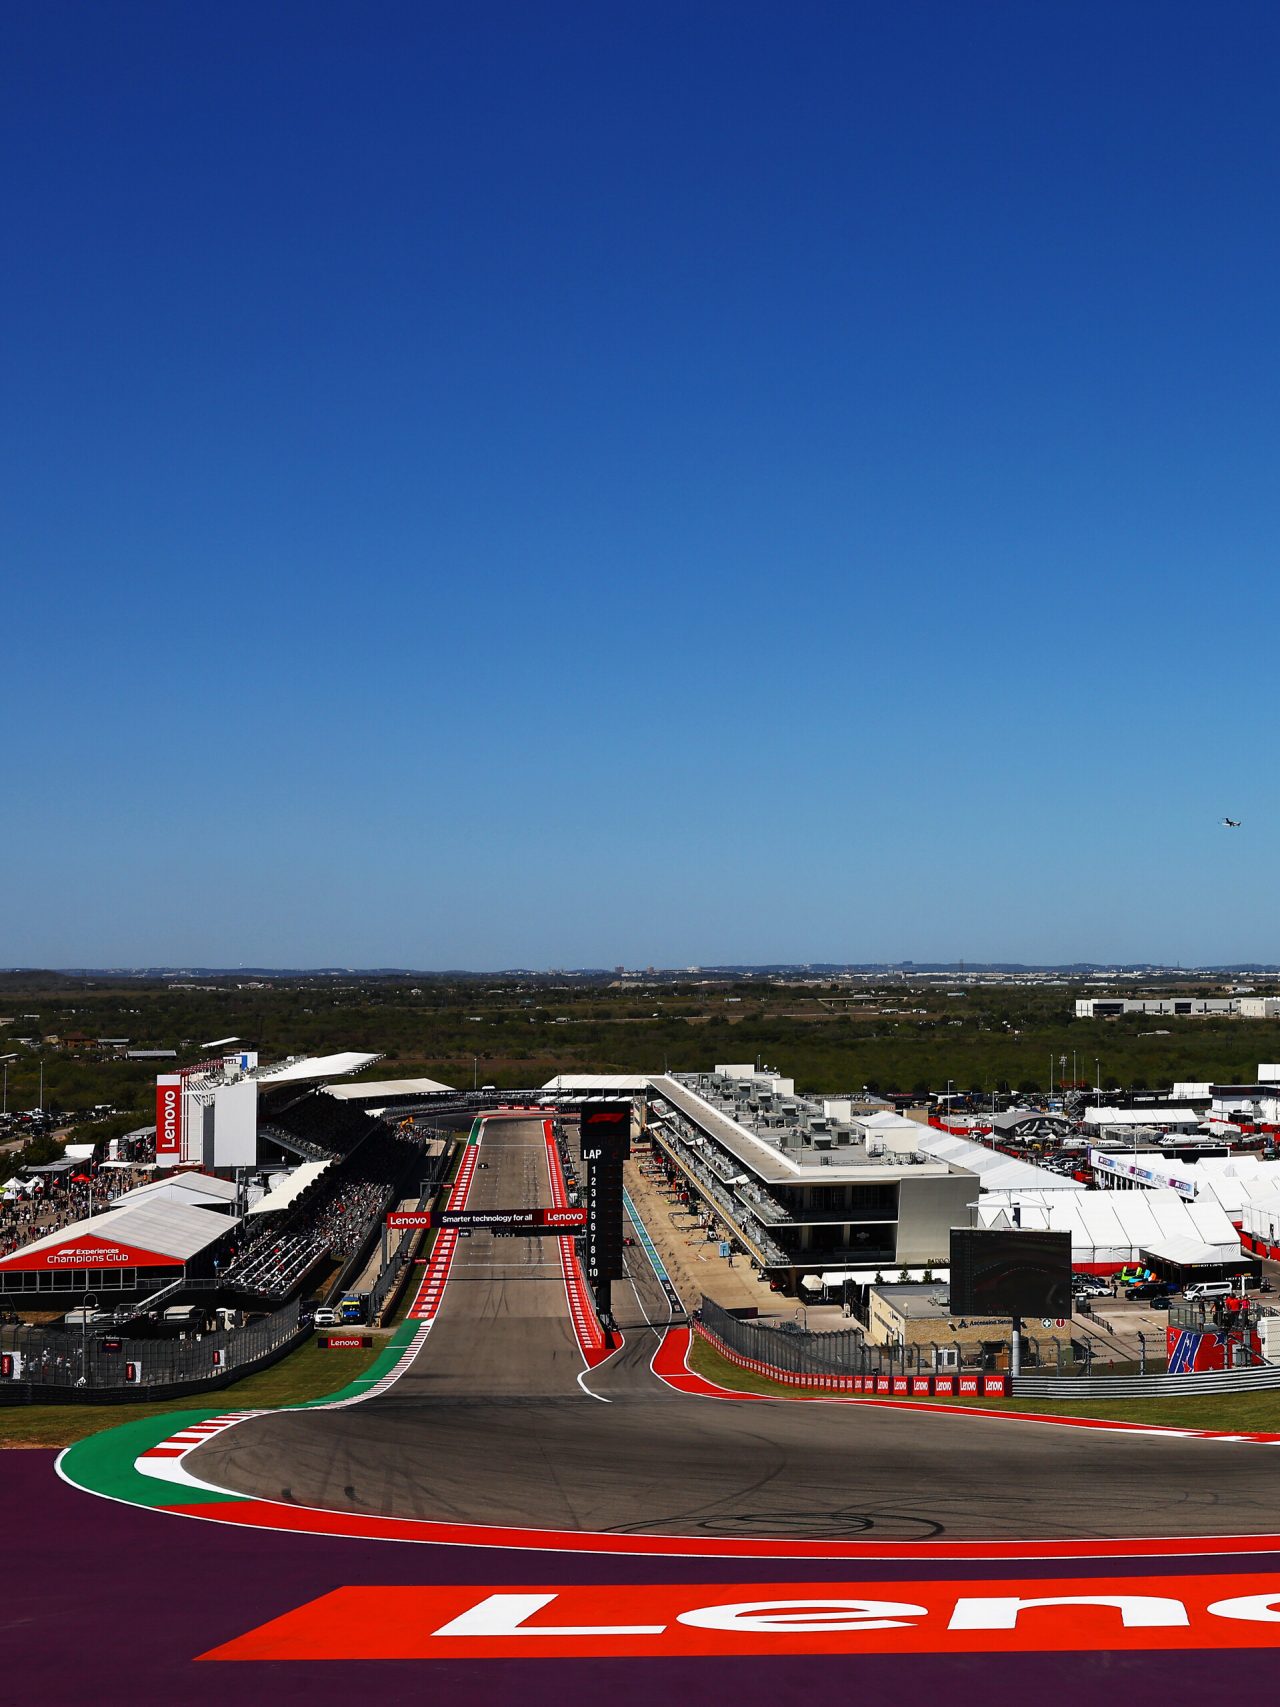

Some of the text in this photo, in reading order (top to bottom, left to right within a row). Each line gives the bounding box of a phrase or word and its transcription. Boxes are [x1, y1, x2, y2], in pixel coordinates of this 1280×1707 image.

[162, 1090, 176, 1148] Lenovo
[584, 1150, 602, 1159] LAP
[390, 1216, 427, 1225] Lenovo
[472, 1214, 512, 1222] technology
[548, 1212, 583, 1221] Lenovo
[47, 1254, 104, 1264] Champions
[894, 1380, 906, 1390] Lenovo
[914, 1380, 928, 1390] Lenovo
[936, 1380, 951, 1391] Lenovo
[960, 1379, 976, 1391] Lenovo
[986, 1379, 1002, 1391] Lenovo
